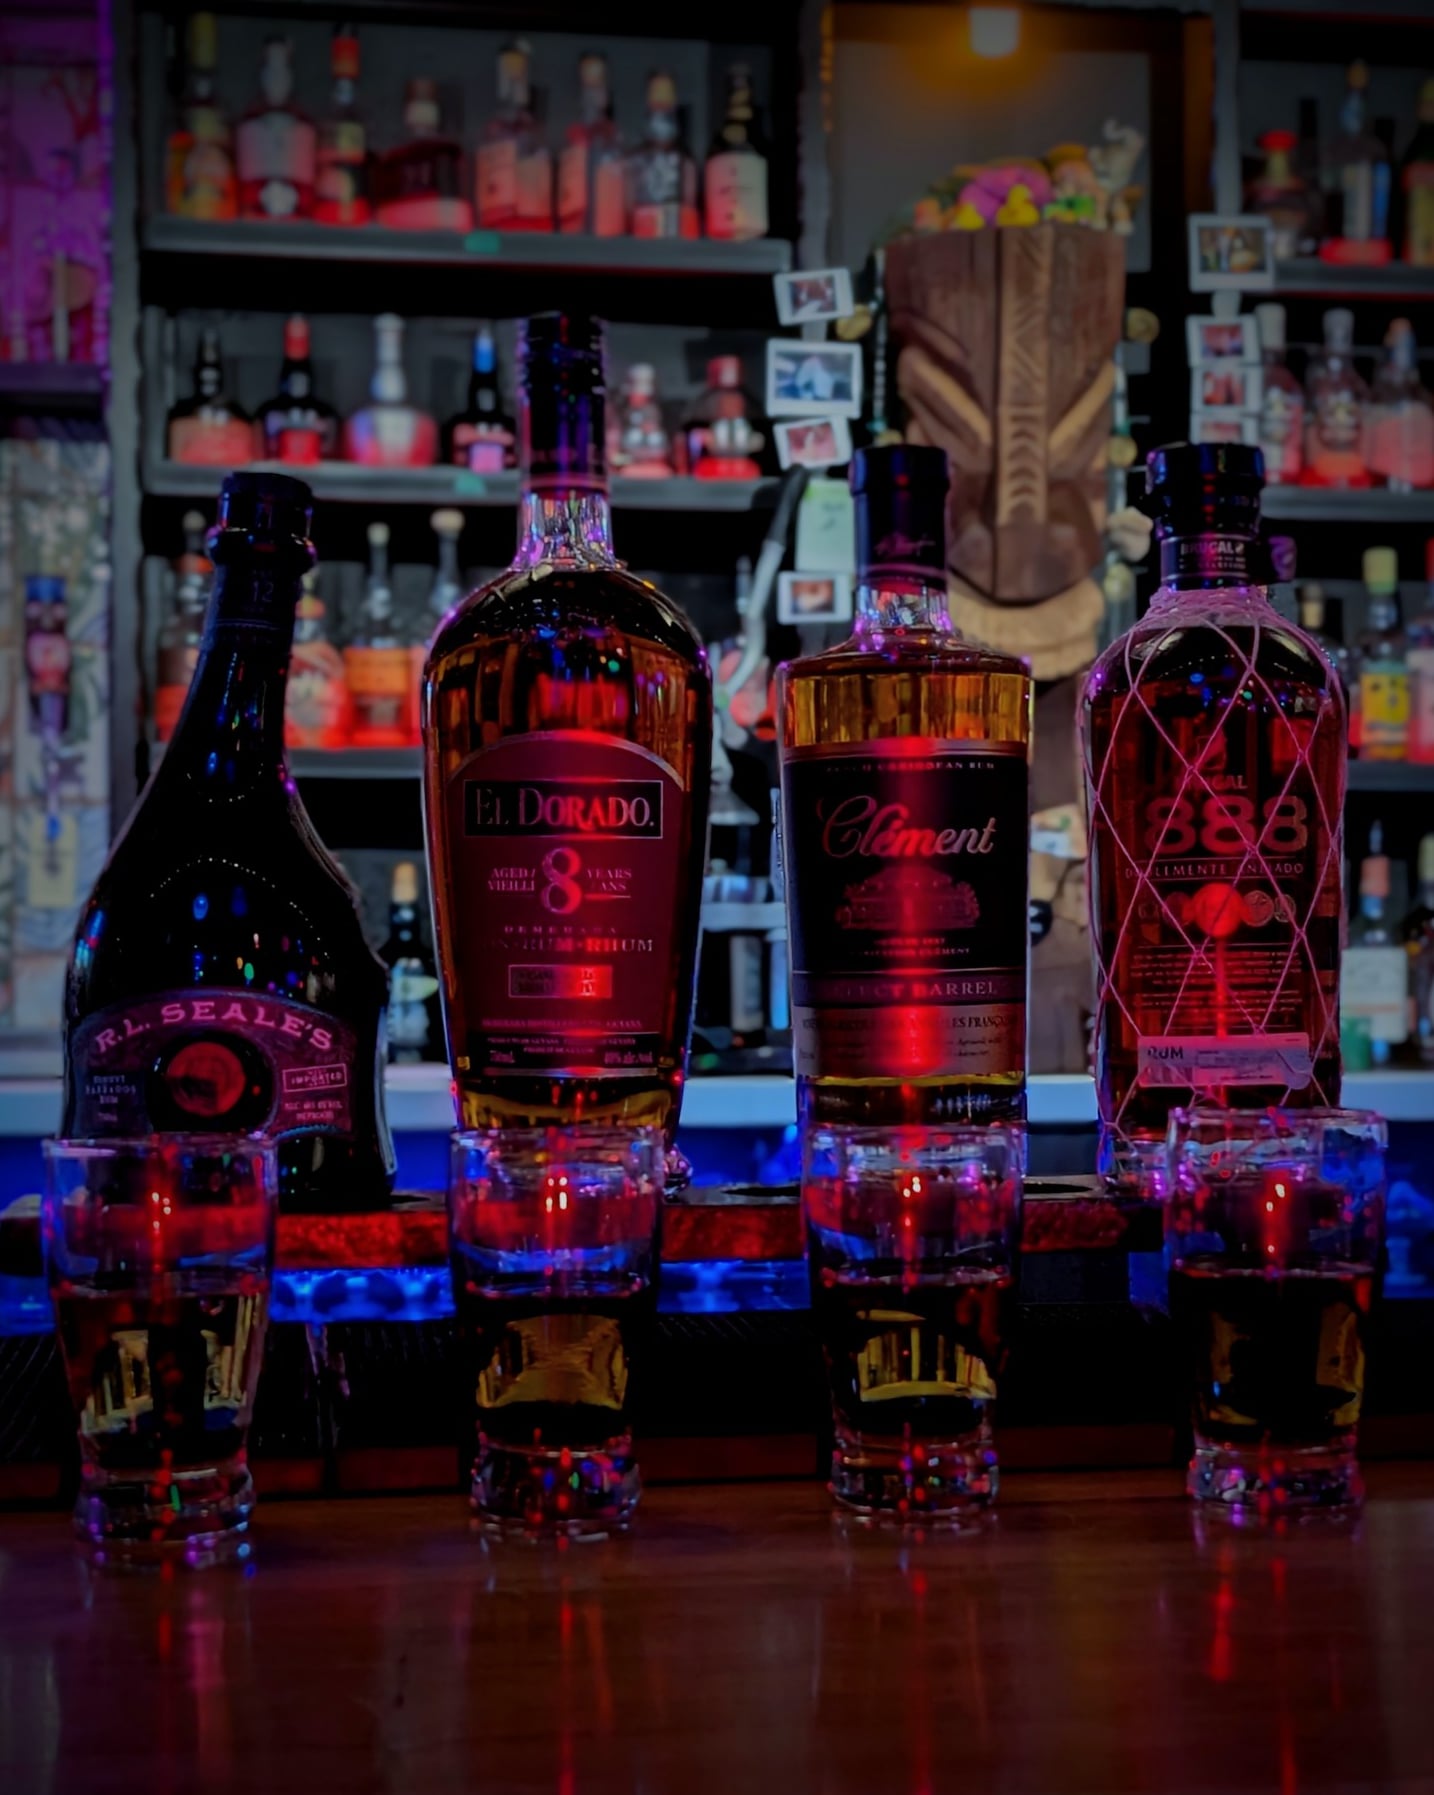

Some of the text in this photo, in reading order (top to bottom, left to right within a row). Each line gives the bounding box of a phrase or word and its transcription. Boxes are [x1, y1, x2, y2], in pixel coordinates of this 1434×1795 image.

[475, 787, 509, 825] EL
[541, 847, 582, 915] 8
[160, 999, 333, 1051] SEALE'S
